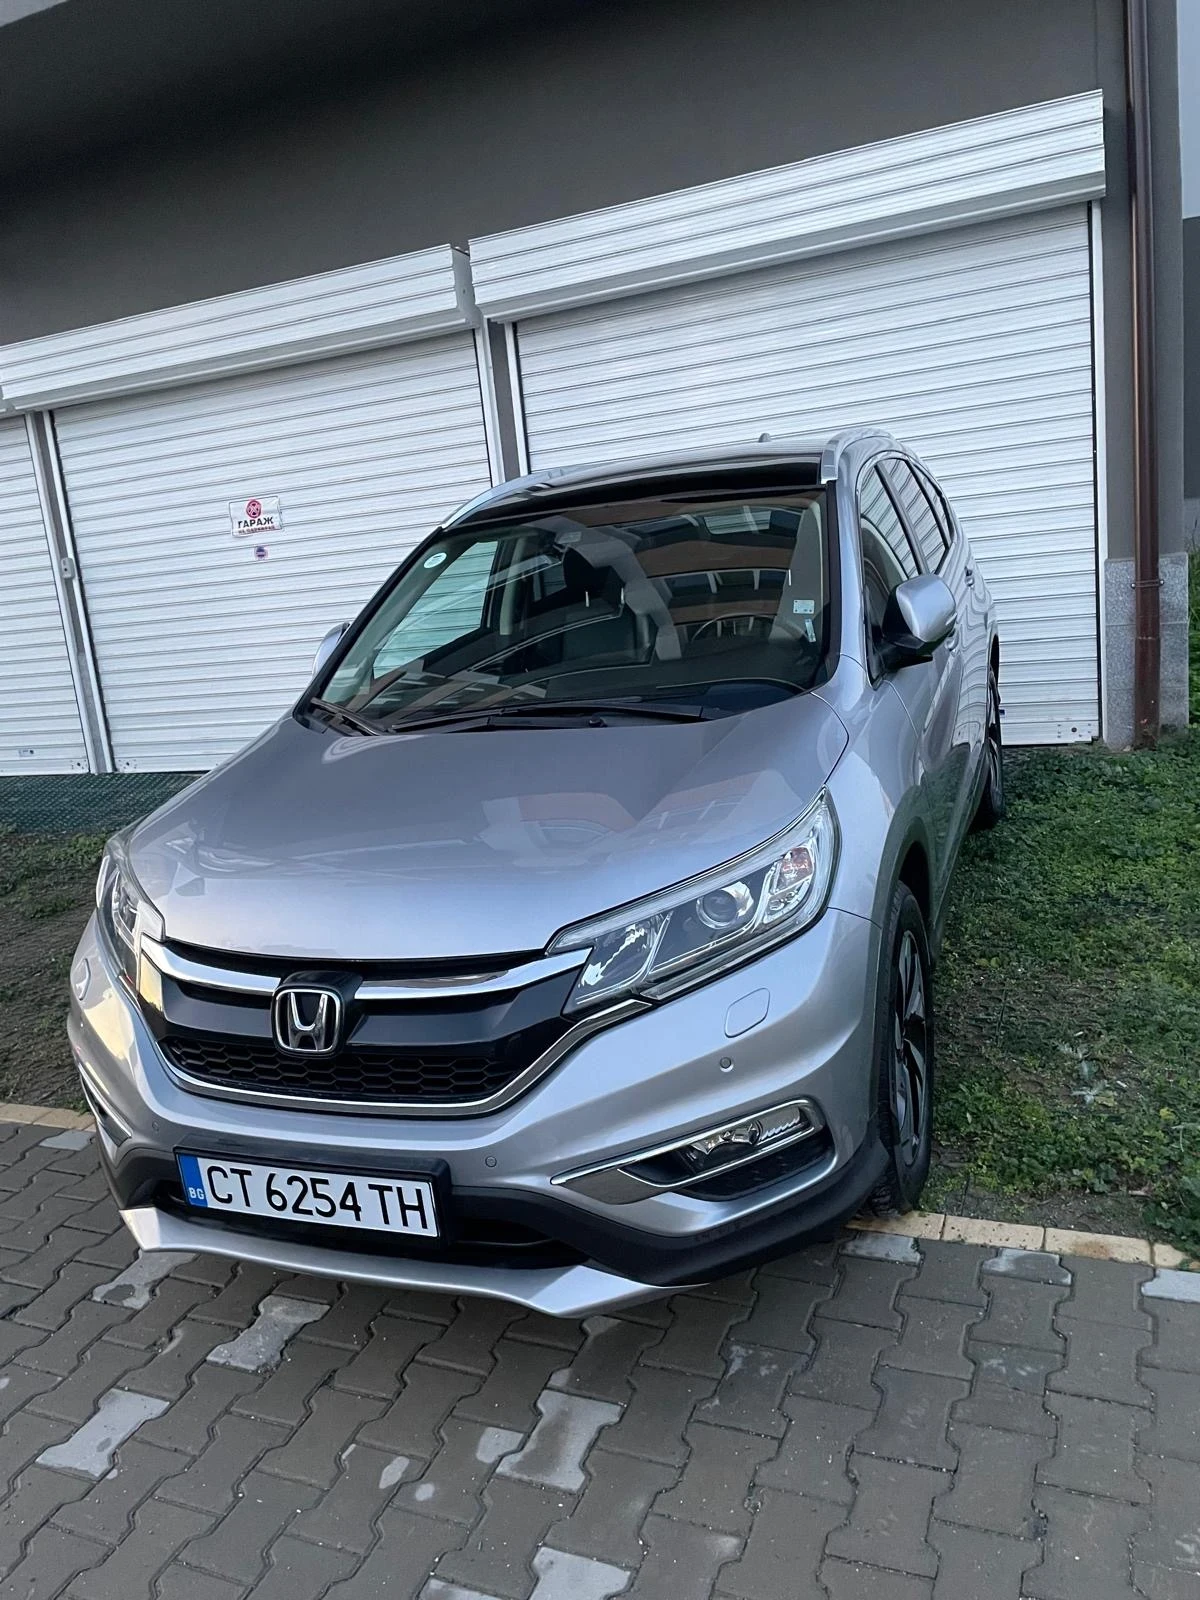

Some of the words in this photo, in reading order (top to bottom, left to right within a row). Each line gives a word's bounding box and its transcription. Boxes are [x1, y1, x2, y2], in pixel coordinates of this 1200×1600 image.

[238, 517, 274, 529] ГАРАЖ
[189, 1187, 205, 1200] BG
[207, 1165, 252, 1207] CT
[266, 1173, 362, 1221] 6254
[368, 1183, 429, 1229] TH
